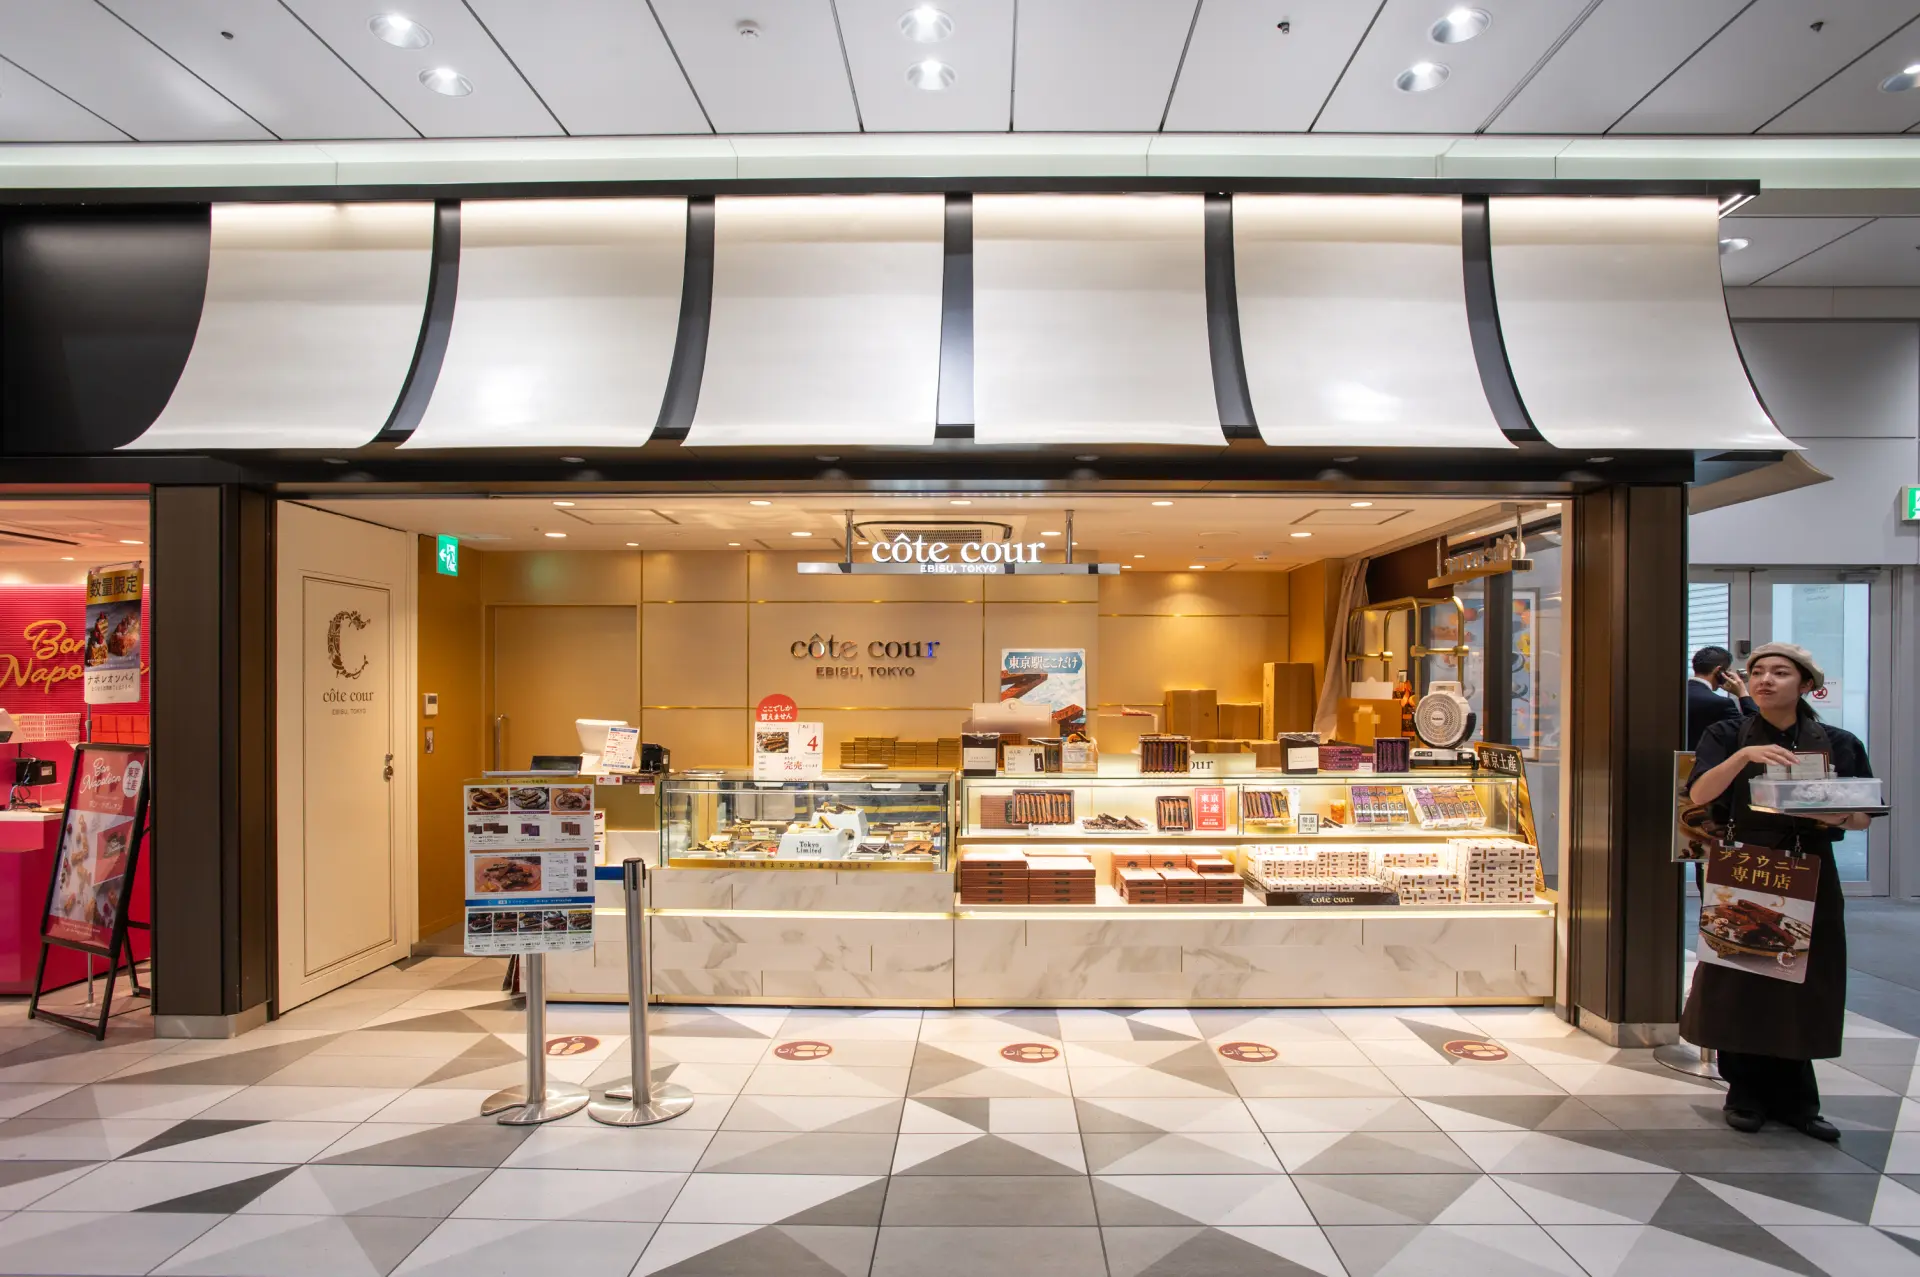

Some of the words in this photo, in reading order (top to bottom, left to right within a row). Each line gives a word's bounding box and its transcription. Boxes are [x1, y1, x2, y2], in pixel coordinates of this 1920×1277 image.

[872, 533, 950, 563] côte
[961, 541, 1045, 563] cour
[920, 564, 957, 574] EBISU,
[961, 564, 997, 573] TOKYO
[90, 575, 138, 598] 数量限定
[790, 633, 857, 659] côte
[868, 640, 940, 659] cour
[1008, 655, 1078, 669] 東京駅ここだけ
[816, 667, 863, 679] EBISU,
[868, 667, 915, 677] TOKYO
[322, 688, 346, 702] côte
[350, 691, 374, 702] cour
[807, 735, 818, 752] 4
[1036, 758, 1043, 769] 1
[1481, 750, 1518, 772] 東京土産
[1200, 793, 1219, 803] 東京
[1201, 803, 1219, 813] 土産
[796, 846, 822, 854] Limited
[799, 841, 819, 849] Tokyo
[1719, 850, 1810, 871] ブラウニー
[1731, 866, 1792, 890] 専門店
[1333, 895, 1355, 903] cour
